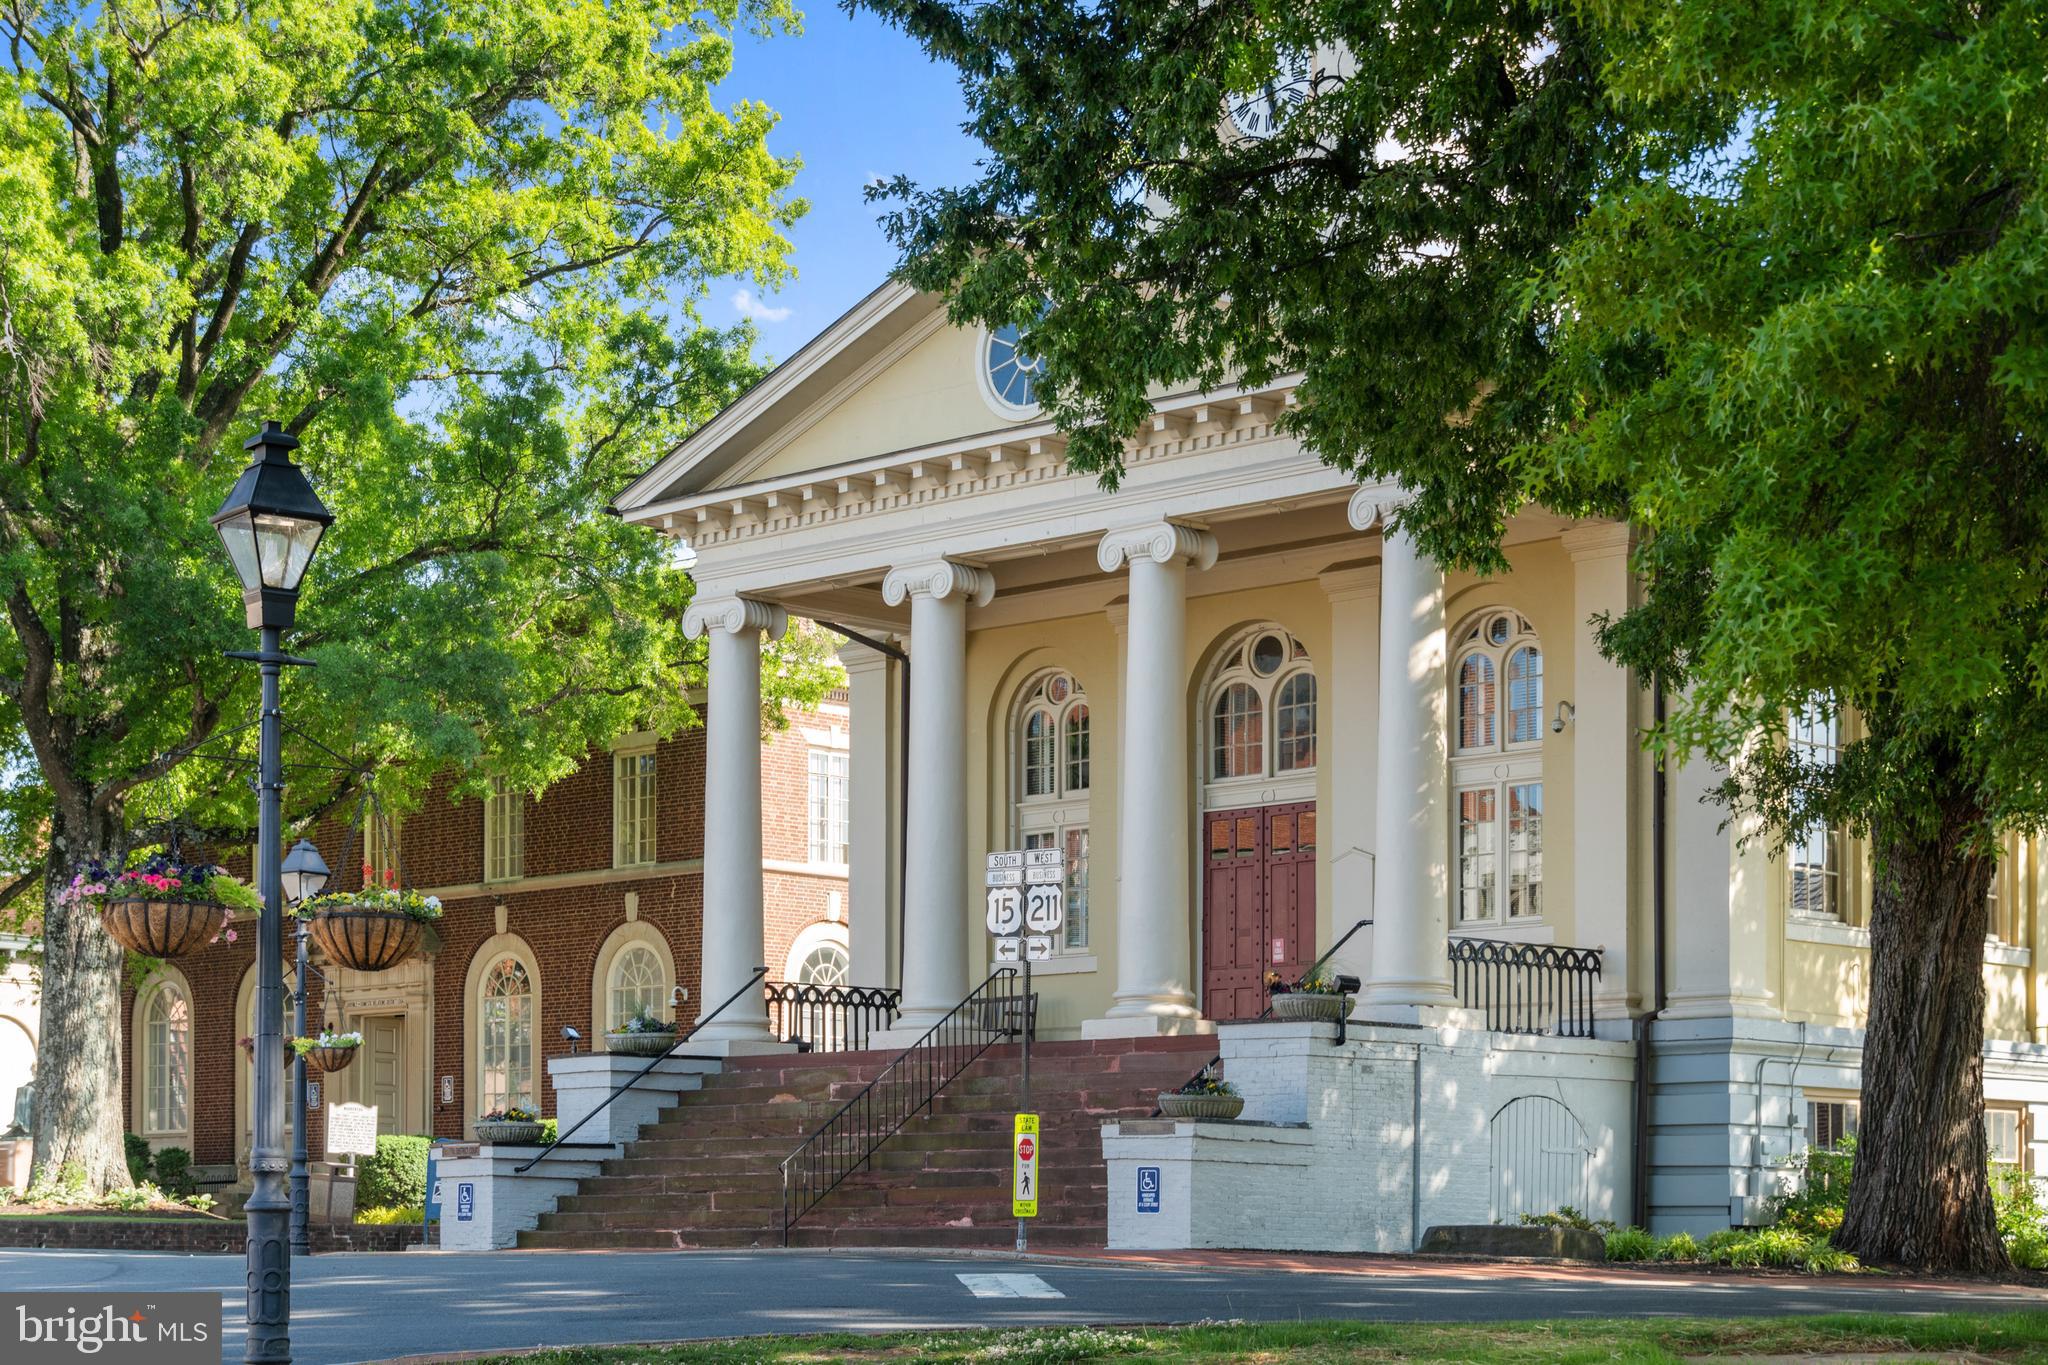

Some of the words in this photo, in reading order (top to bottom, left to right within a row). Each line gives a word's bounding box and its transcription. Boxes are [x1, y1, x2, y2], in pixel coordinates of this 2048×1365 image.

[994, 856, 1016, 866] SOUTH
[1034, 853, 1053, 863] WEST
[993, 874, 1015, 882] BUSINESS
[1033, 870, 1055, 880] BUSINESS
[995, 898, 1013, 924] 15
[1031, 895, 1057, 921] 211
[1019, 1116, 1035, 1124] STATE
[1019, 1145, 1033, 1154] STOP
